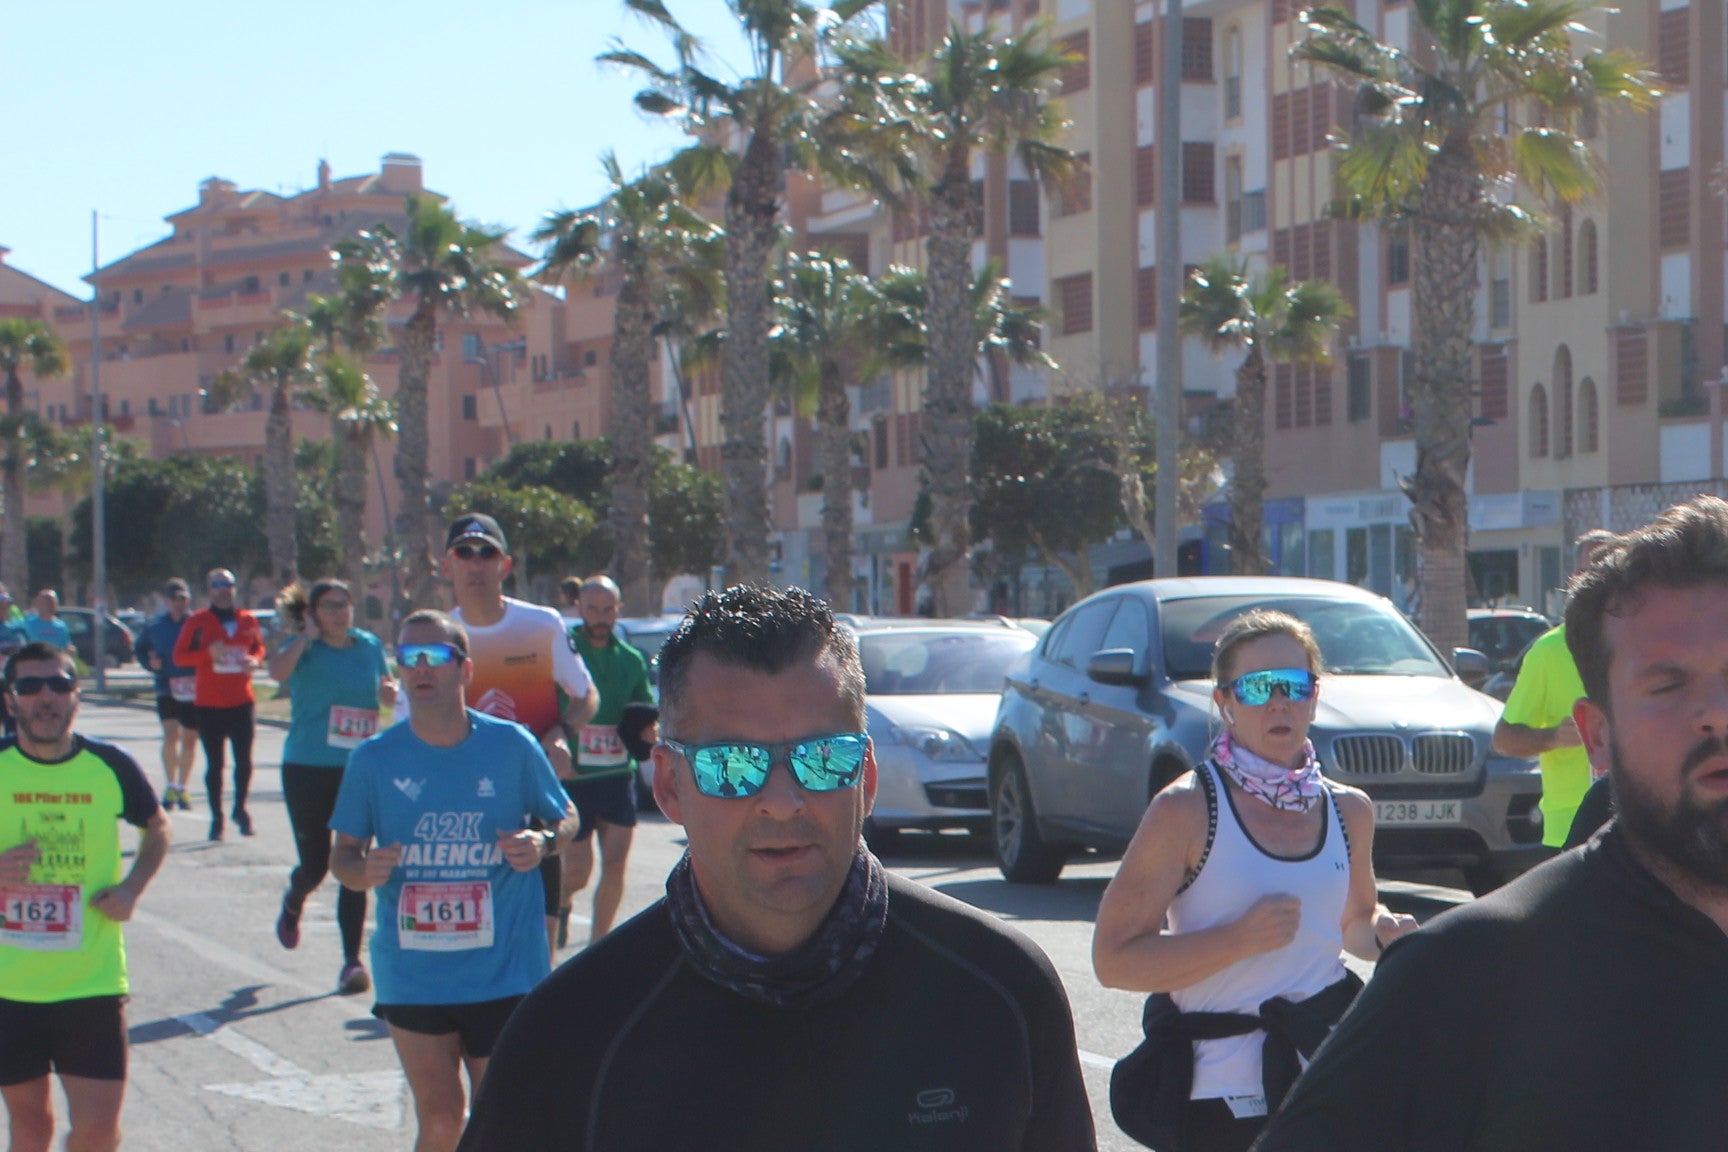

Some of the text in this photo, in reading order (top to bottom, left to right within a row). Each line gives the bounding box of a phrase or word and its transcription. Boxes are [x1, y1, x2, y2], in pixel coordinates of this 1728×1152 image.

[1376, 803, 1457, 820] 1238 JJK
[414, 812, 484, 842] 42K
[12, 901, 57, 922] 162
[423, 902, 465, 922] 161
